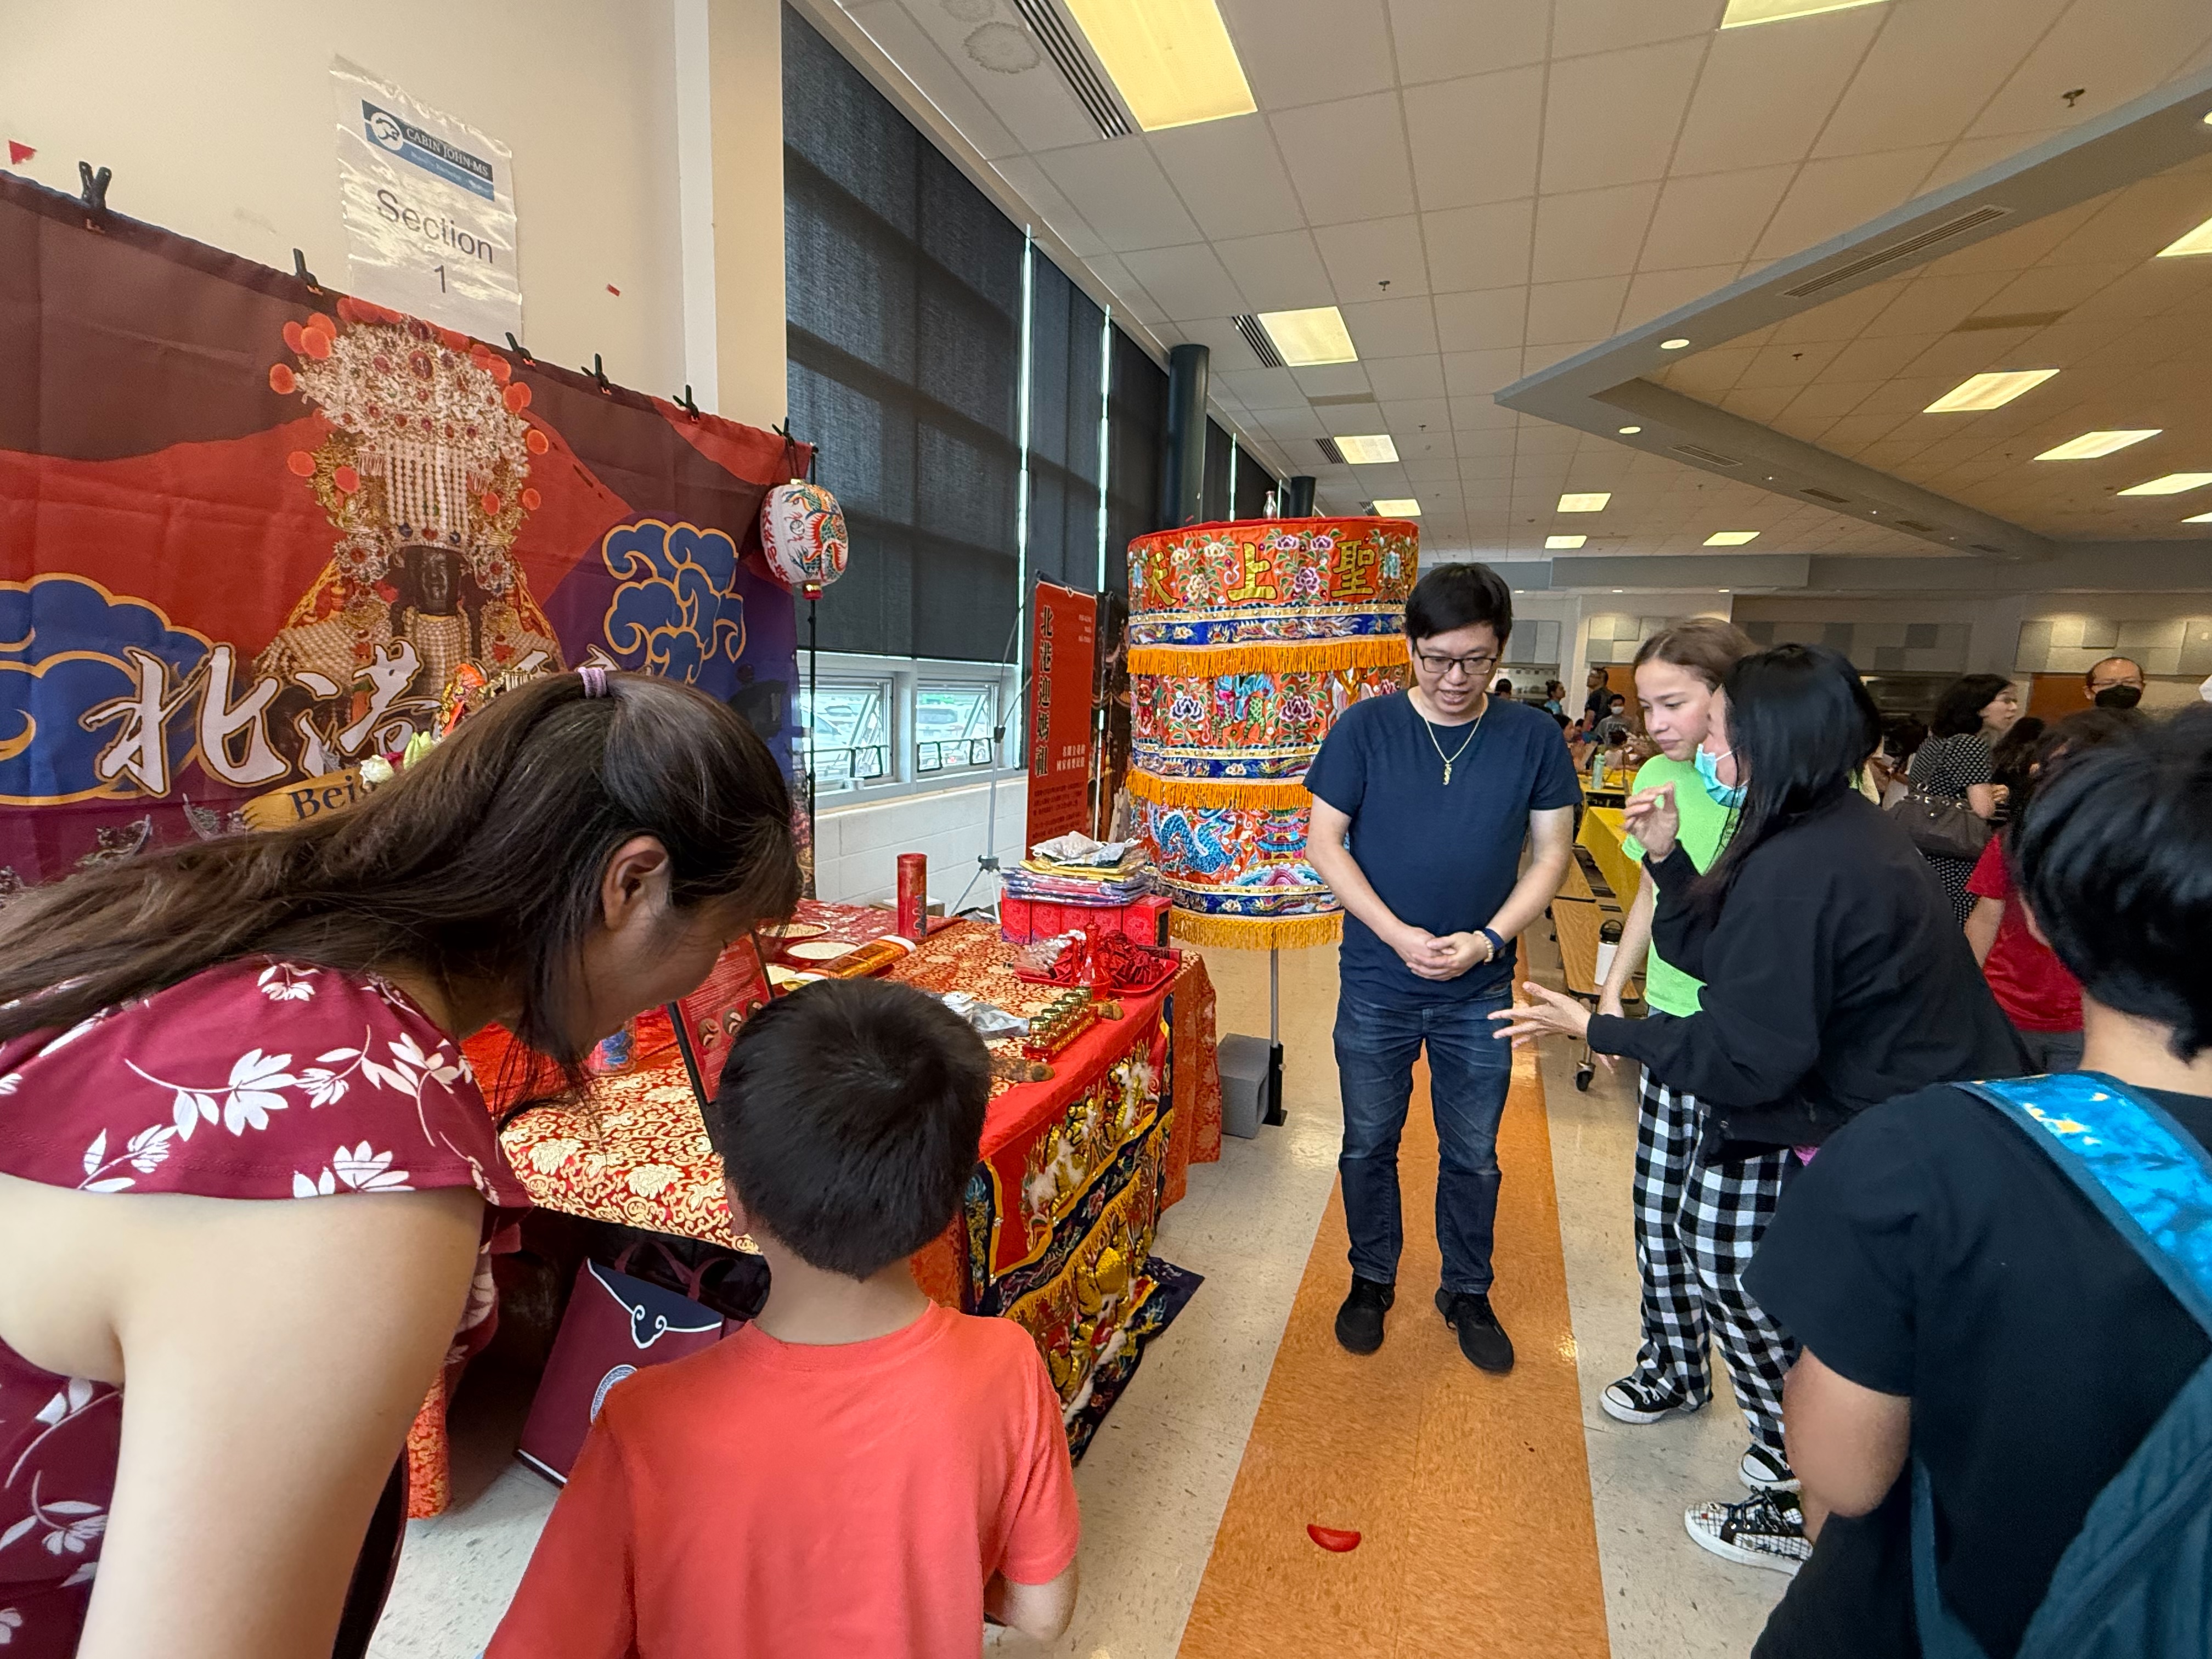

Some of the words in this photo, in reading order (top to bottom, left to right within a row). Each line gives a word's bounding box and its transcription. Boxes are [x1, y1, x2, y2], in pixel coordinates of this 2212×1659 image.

[406, 127, 441, 154] CABIN
[443, 144, 470, 168] JOHN
[472, 161, 489, 177] MS
[376, 189, 493, 264] Section
[434, 264, 446, 294] 1
[288, 775, 376, 820] Bei
